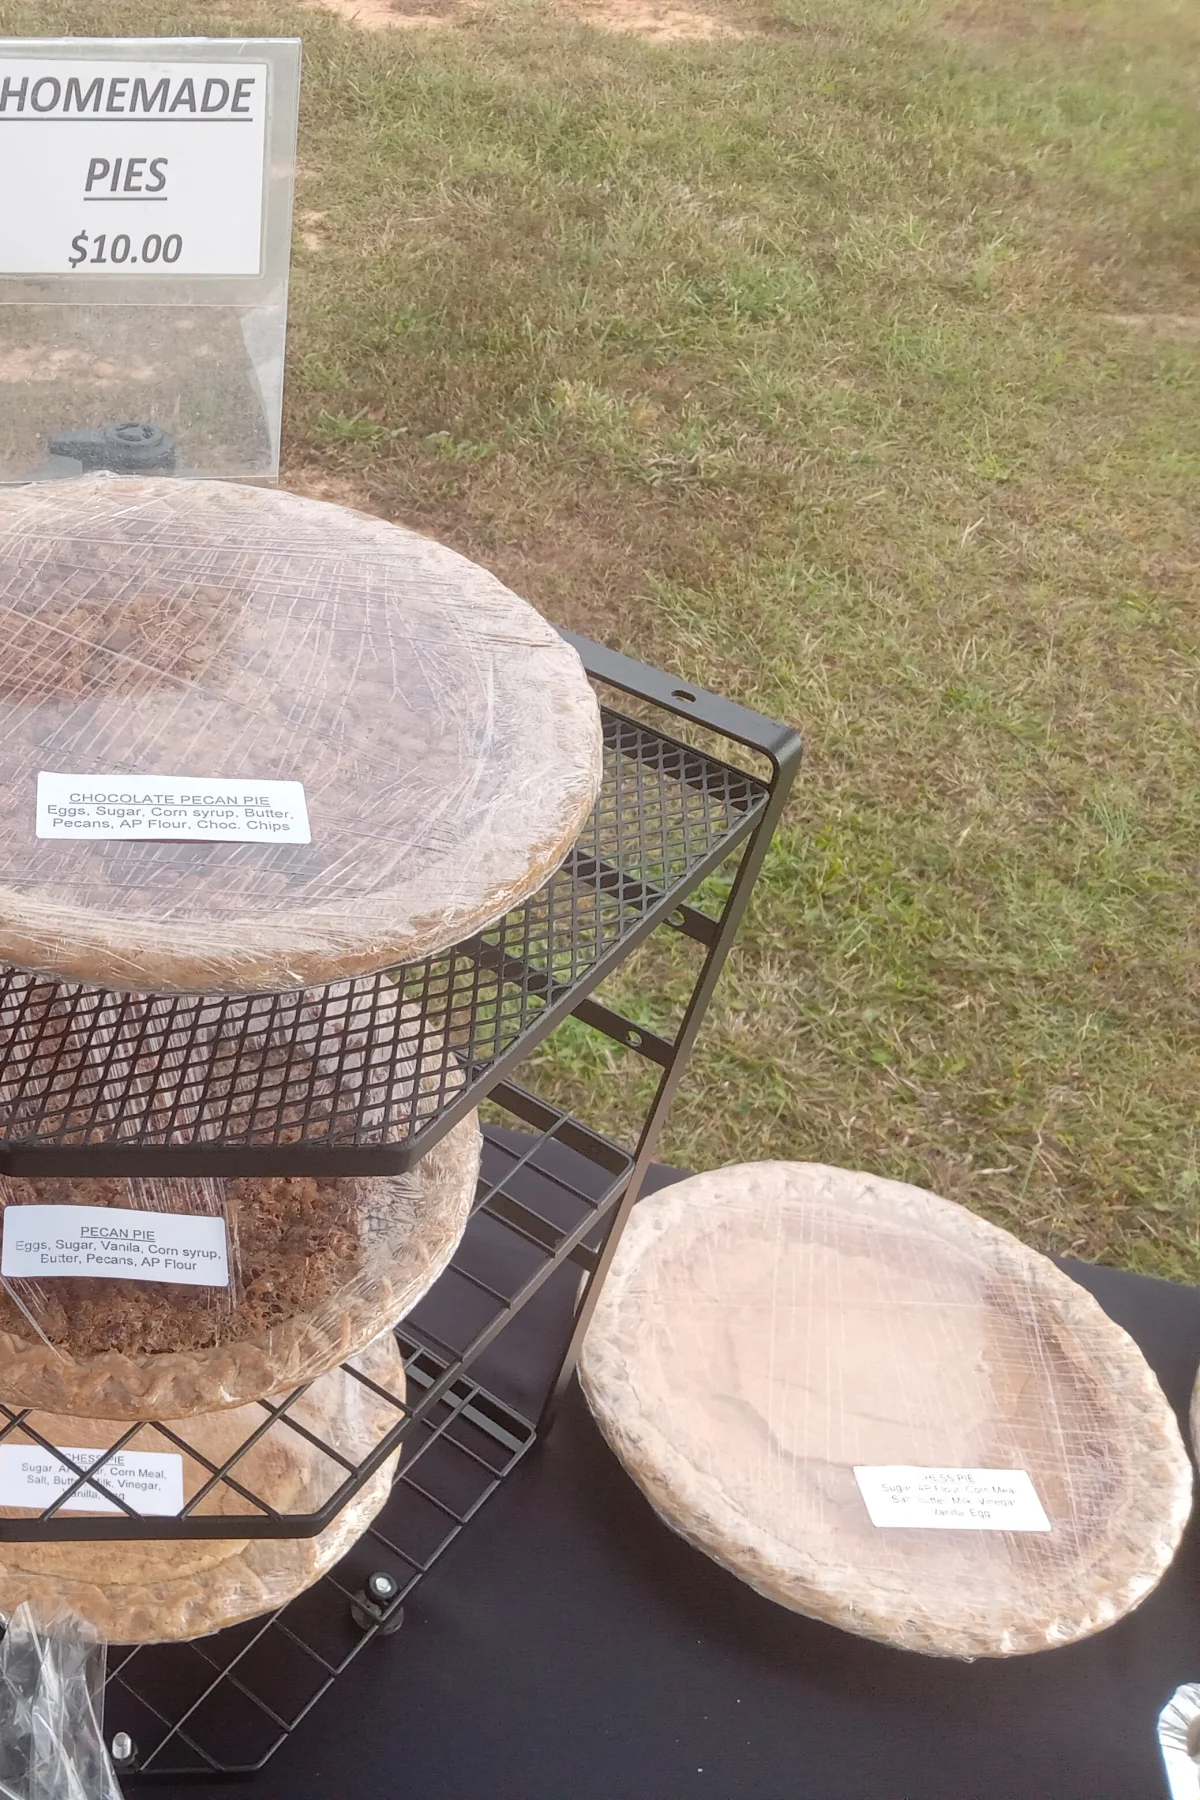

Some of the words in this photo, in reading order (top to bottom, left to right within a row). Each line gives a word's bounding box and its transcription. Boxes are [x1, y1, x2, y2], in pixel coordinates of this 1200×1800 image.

[83, 157, 169, 193] PIES
[68, 229, 183, 268] $10.00
[69, 793, 175, 805] CHOCOLATE
[180, 795, 238, 805] PECAN
[243, 796, 271, 807] PIE
[47, 804, 90, 817] Eggs,
[96, 806, 146, 818] Sugar,
[151, 807, 188, 817] Corn
[193, 809, 239, 819] syrup,
[244, 808, 294, 820] Butter,
[52, 818, 114, 830] Pecans,
[119, 819, 142, 829] AP
[148, 819, 192, 830] Flour,
[197, 820, 241, 830] Choc.
[246, 820, 291, 832] Chips
[80, 1226, 129, 1239] PECAN
[133, 1229, 156, 1242] PIE
[16, 1240, 51, 1253] Eggs,
[55, 1239, 97, 1252] Sugar,
[148, 1244, 179, 1256] Corn
[182, 1247, 222, 1261] syrup,
[40, 1253, 82, 1265] Butter,
[86, 1254, 138, 1267] Pecans,
[140, 1257, 160, 1268] AP
[164, 1258, 198, 1272] Flour
[110, 1466, 136, 1477] Corn
[138, 1468, 167, 1480] Meal,
[27, 1475, 50, 1486] Salt,
[117, 1479, 162, 1492] Vinegar,
